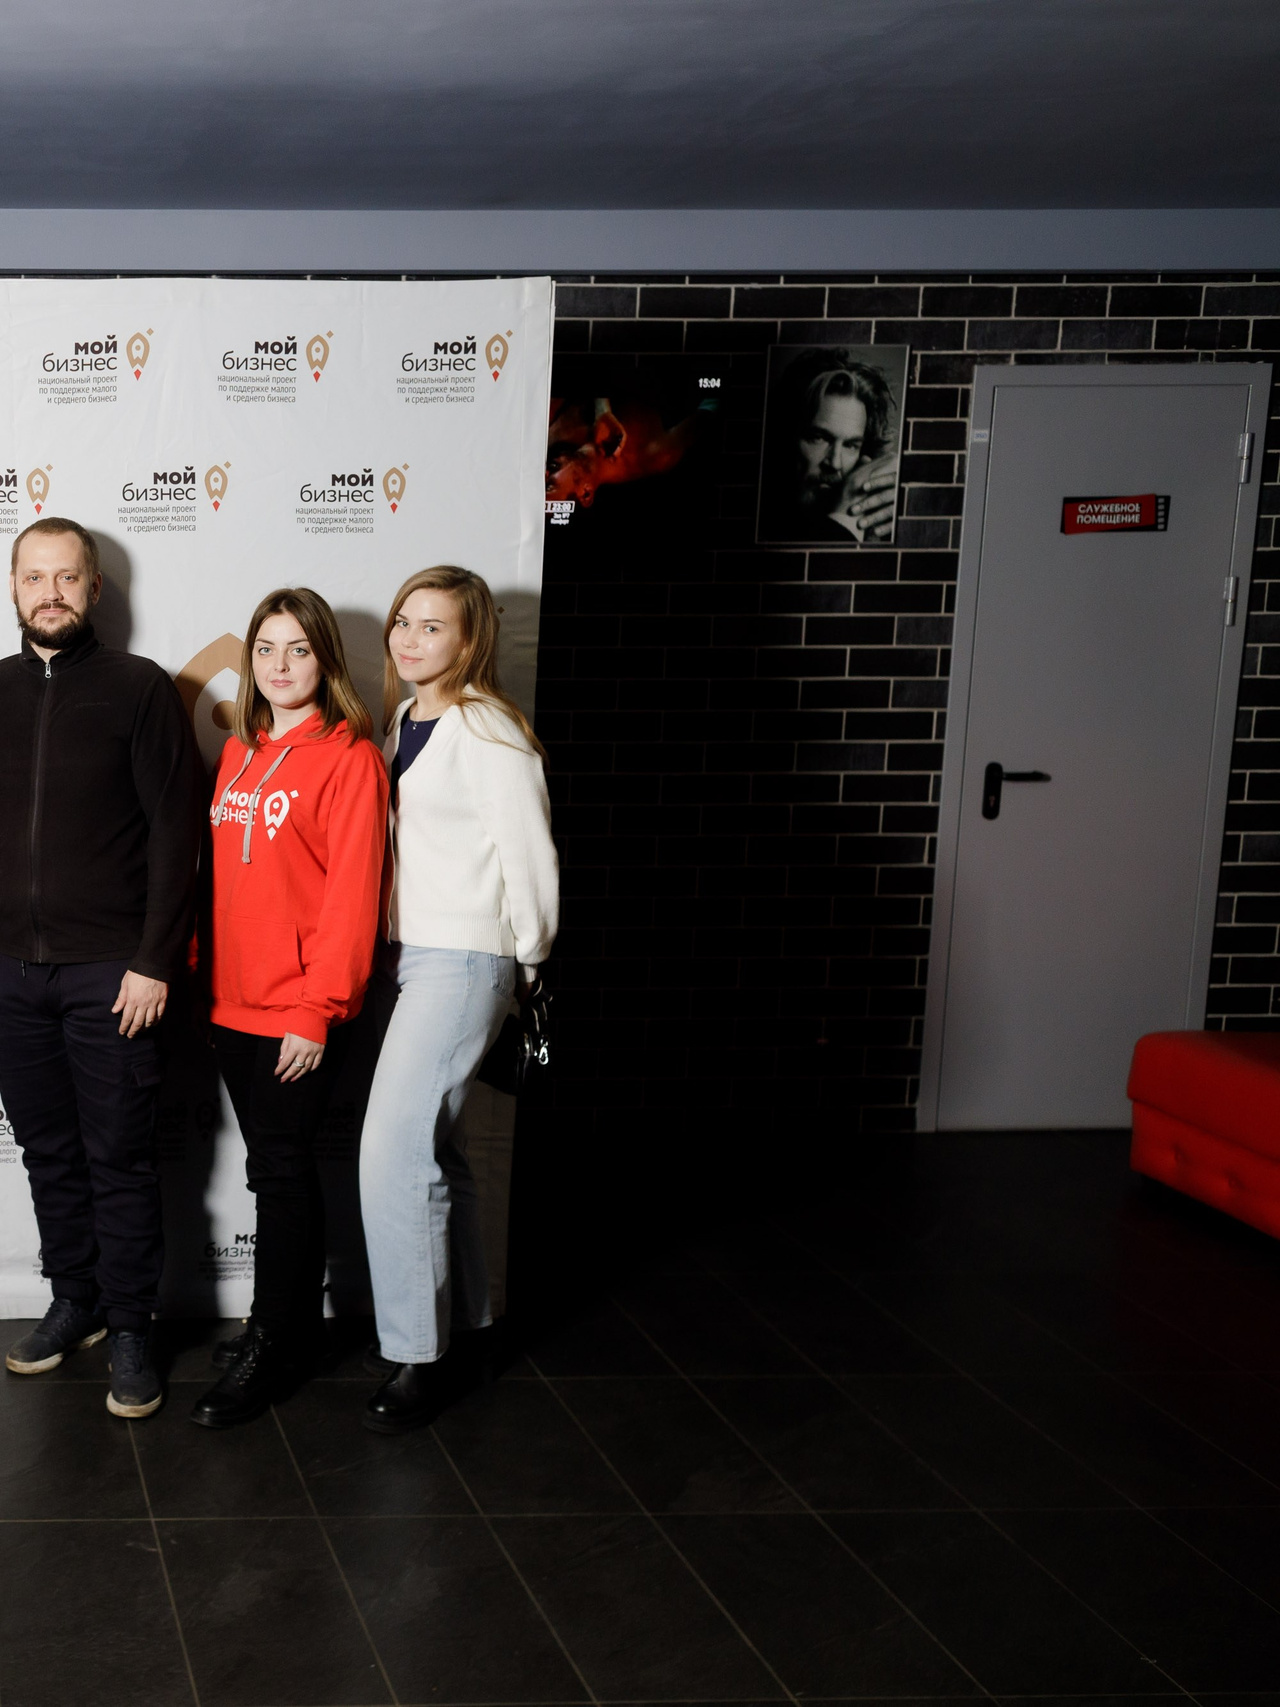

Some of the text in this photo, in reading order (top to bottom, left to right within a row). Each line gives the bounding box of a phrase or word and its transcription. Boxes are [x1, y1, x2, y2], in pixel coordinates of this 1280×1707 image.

[75, 335, 117, 355] мой
[255, 336, 297, 354] мой
[434, 336, 476, 355] мой
[43, 353, 117, 372] бизнес
[223, 350, 296, 371] бизнес
[402, 352, 475, 371] бизнес
[38, 375, 117, 385] национальный проект
[217, 375, 296, 384] национальный проект
[396, 375, 475, 384] национальный проект
[699, 378, 721, 388] 15:04
[50, 386, 89, 395] поддержке
[229, 385, 268, 394] поддержке
[408, 386, 447, 395] поддержке
[54, 396, 86, 405] среднего
[88, 394, 117, 402] бизнеса
[233, 395, 265, 403] среднего
[267, 394, 296, 402] бизнеса
[411, 396, 444, 404] среднего
[446, 394, 474, 402] бизнеса
[154, 466, 195, 484] мой
[332, 468, 373, 486] мой
[122, 482, 196, 501] бизнес
[300, 483, 373, 502] бизнес
[118, 505, 169, 514] национальный
[296, 506, 347, 515] национальный
[1078, 503, 1140, 513] СЛУЖЕБНОЕ
[130, 516, 169, 524] поддержке
[307, 517, 346, 525] поддержке
[1076, 514, 1140, 525] ПОМЕЩЕНИЕ
[134, 525, 166, 533] среднего
[168, 523, 196, 531] бизнеса
[345, 525, 373, 533] бизнеса
